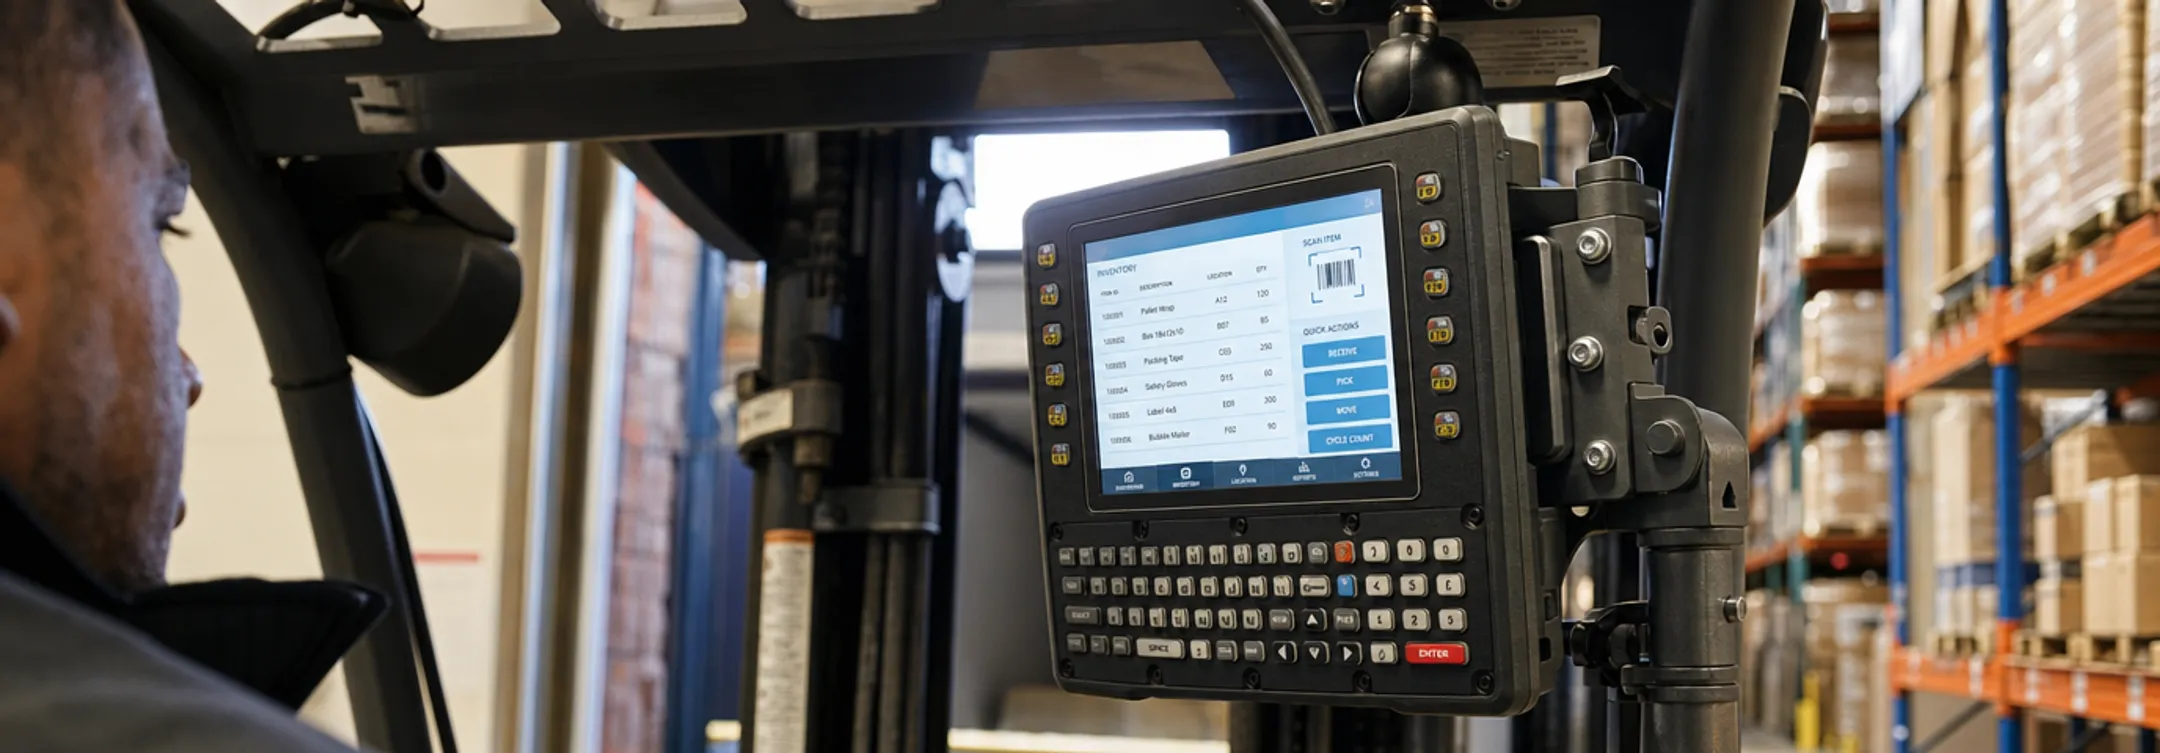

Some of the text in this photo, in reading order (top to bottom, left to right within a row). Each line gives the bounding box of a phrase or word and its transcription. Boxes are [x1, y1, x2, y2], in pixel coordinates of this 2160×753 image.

[1302, 233, 1342, 247] SCAN ITEM
[1097, 264, 1137, 277] INVENTORY
[1257, 289, 1270, 298] 120
[1215, 295, 1228, 304] A12
[1303, 321, 1360, 336] QUICK ACTIONS
[1328, 346, 1358, 357] RECEIVE
[1166, 379, 1188, 389] Gloves
[1336, 376, 1354, 386] PICK
[1147, 406, 1164, 416] Label
[1336, 405, 1357, 414] MOVE
[1266, 421, 1277, 431] 90
[1325, 432, 1374, 446] CYCLE COUNT
[1411, 614, 1418, 626] 2
[1418, 648, 1449, 658] ENTER
